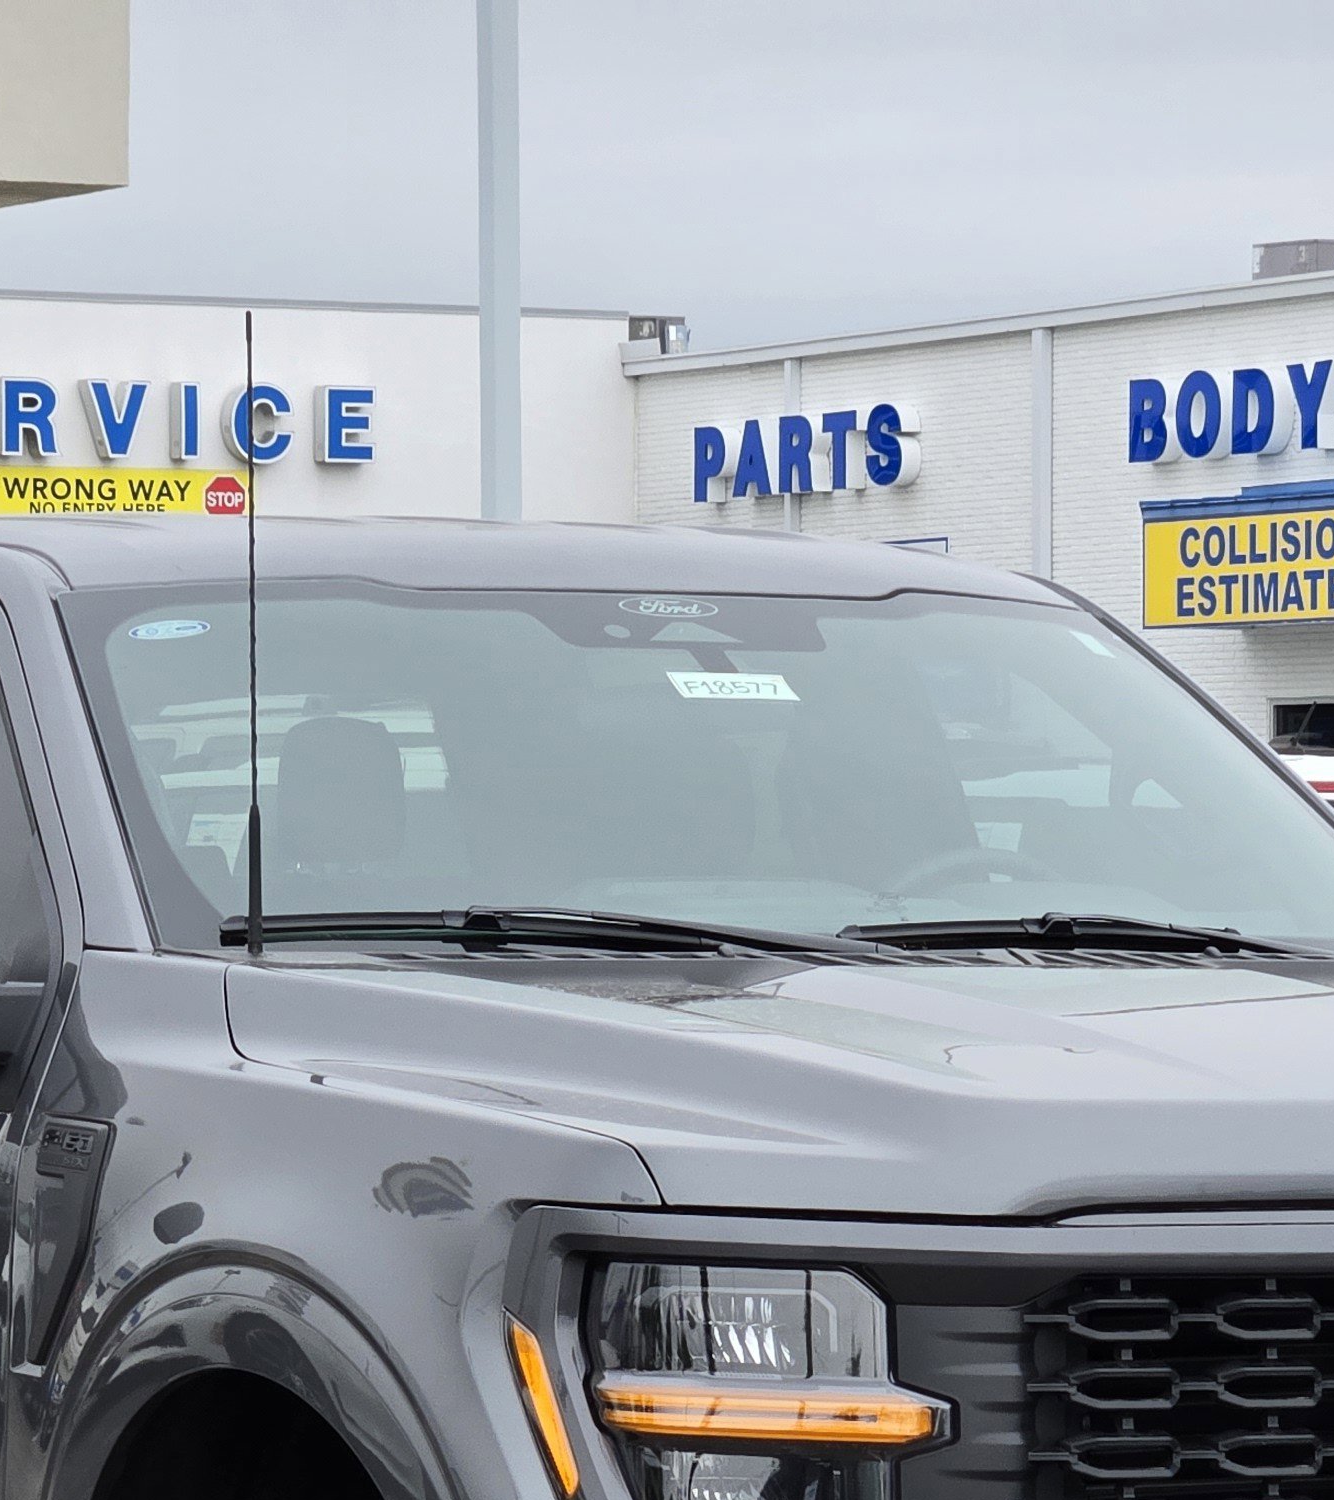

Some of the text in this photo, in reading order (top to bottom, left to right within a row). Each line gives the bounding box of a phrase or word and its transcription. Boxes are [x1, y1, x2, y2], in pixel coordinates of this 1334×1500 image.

[1128, 361, 1333, 463] BODY
[694, 404, 905, 502] PARTS
[3, 477, 191, 502] WRONG WAY
[207, 491, 244, 507] STOP
[639, 600, 701, 614] Ford
[683, 680, 778, 695] F18577
